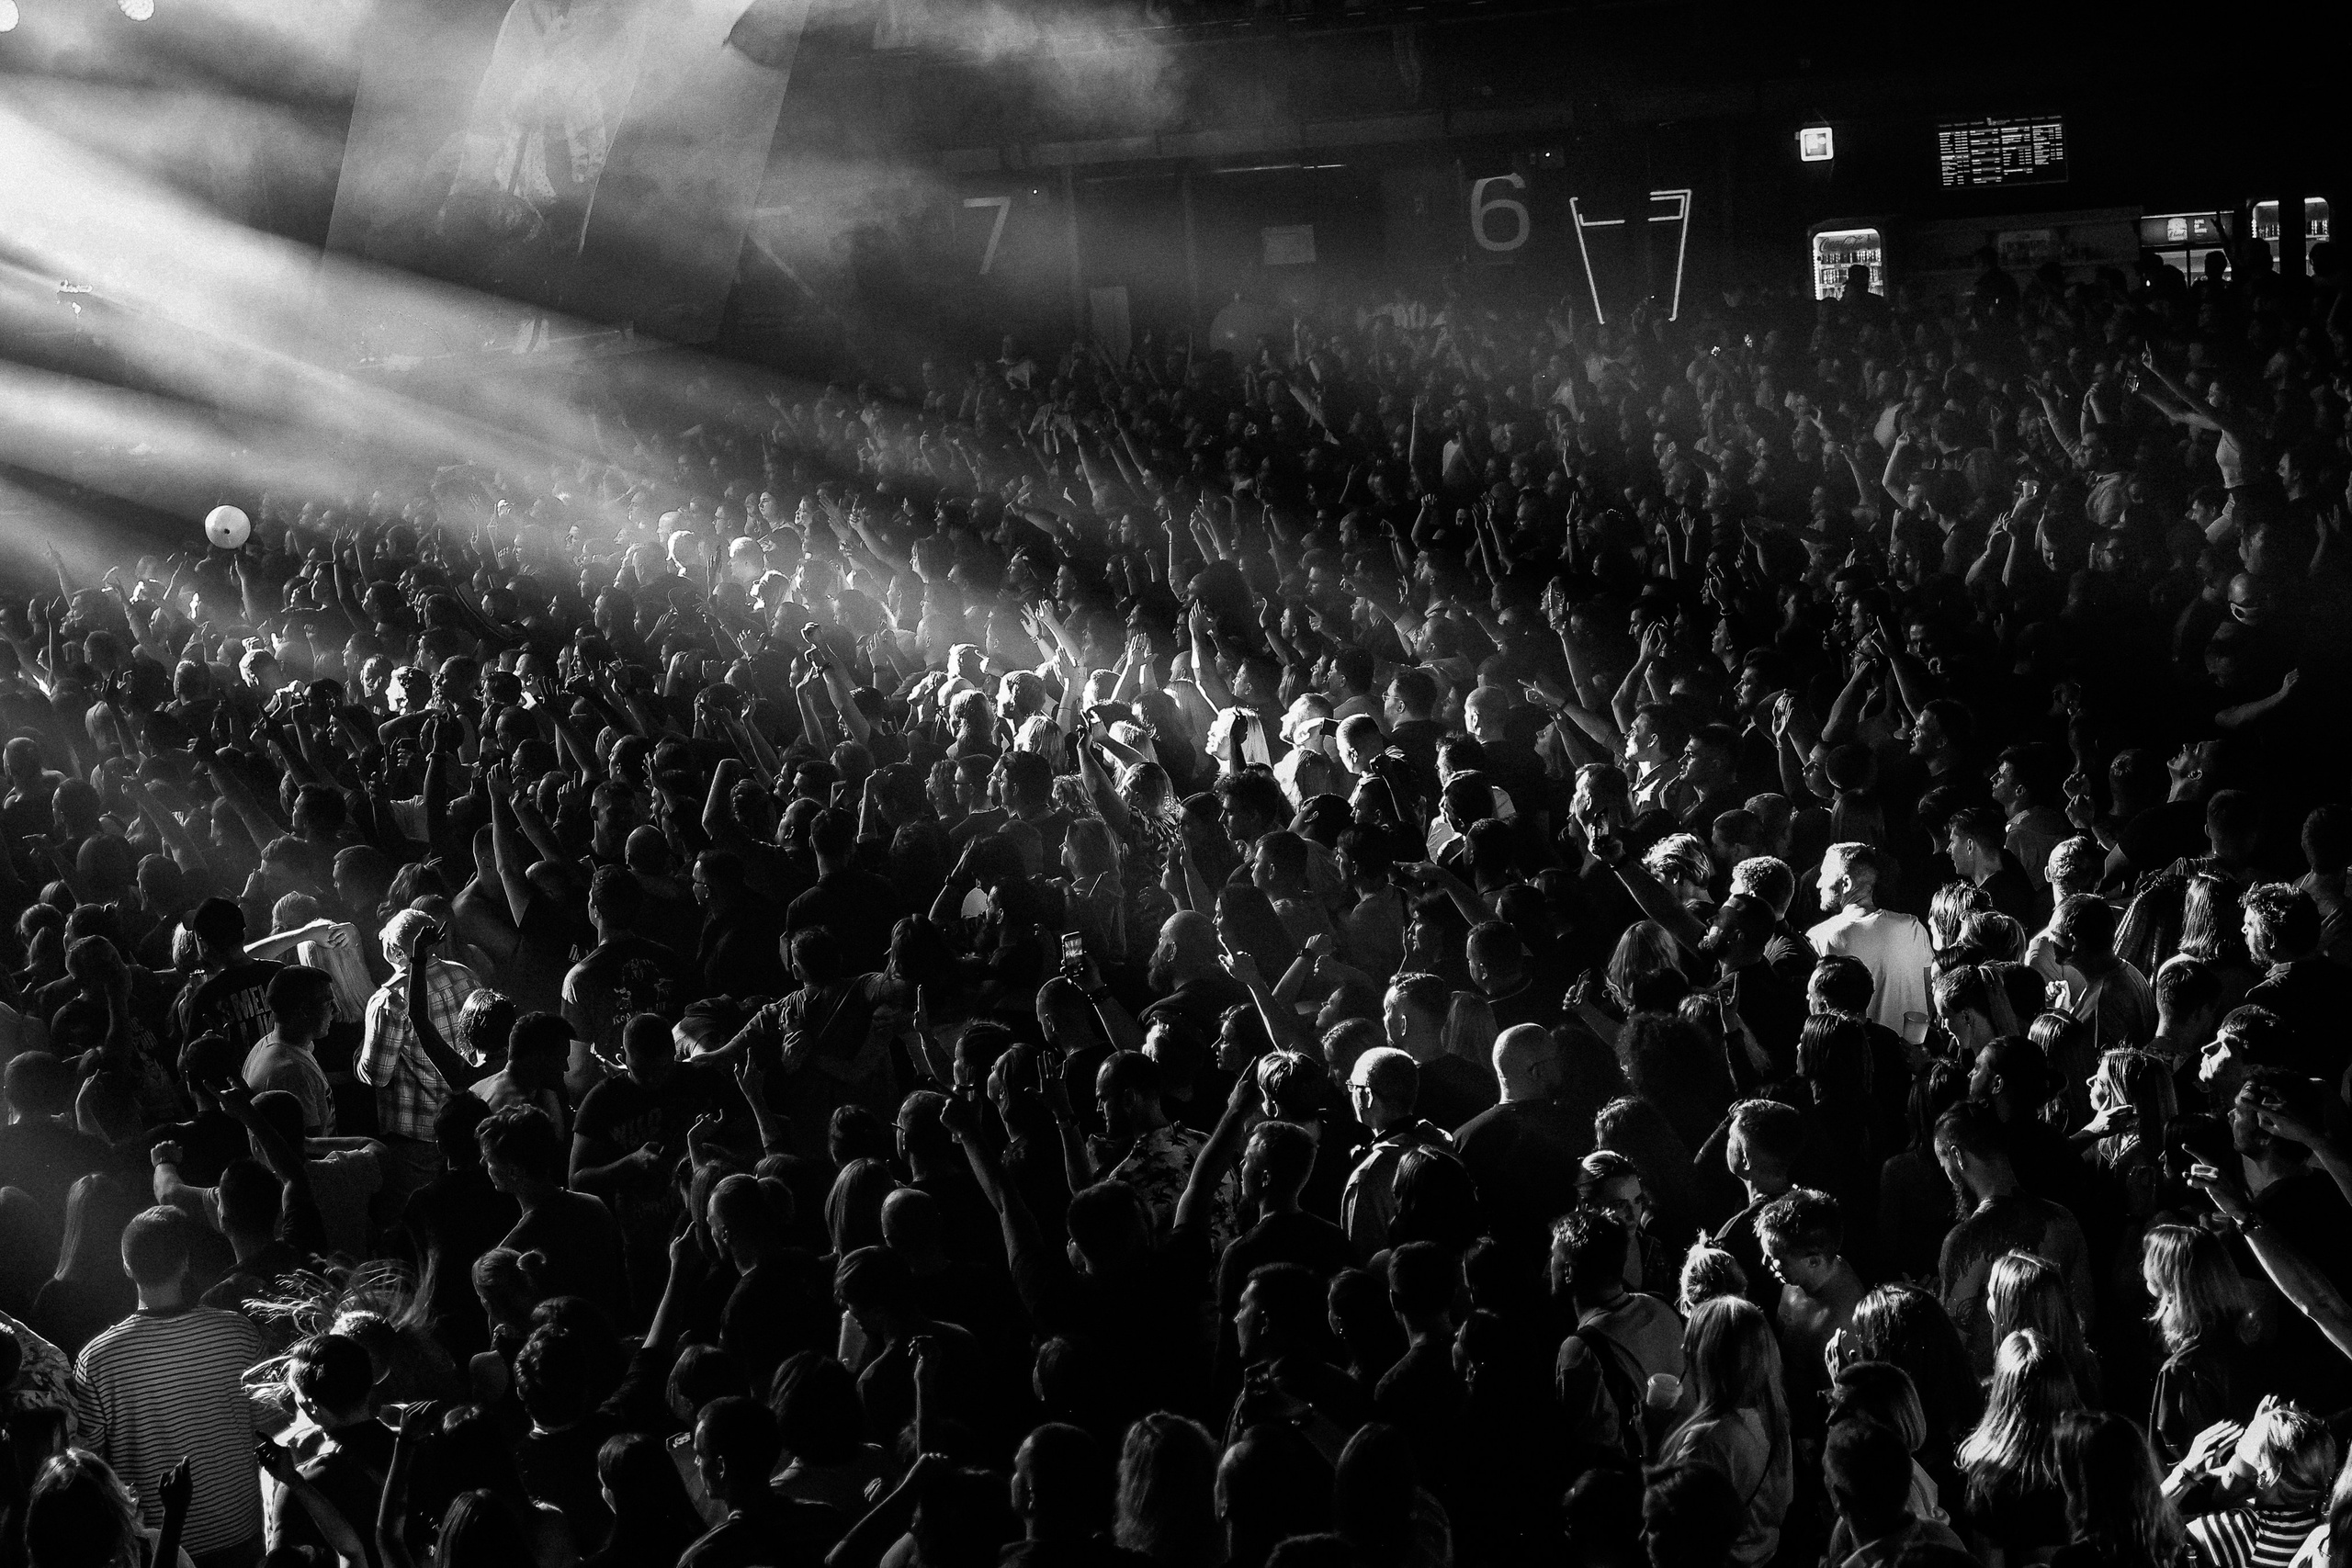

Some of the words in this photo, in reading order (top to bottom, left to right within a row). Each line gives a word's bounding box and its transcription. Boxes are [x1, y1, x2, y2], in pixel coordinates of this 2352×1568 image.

[963, 196, 1012, 276] 7
[1470, 172, 1530, 253] 6
[216, 984, 272, 1023] SMEL
